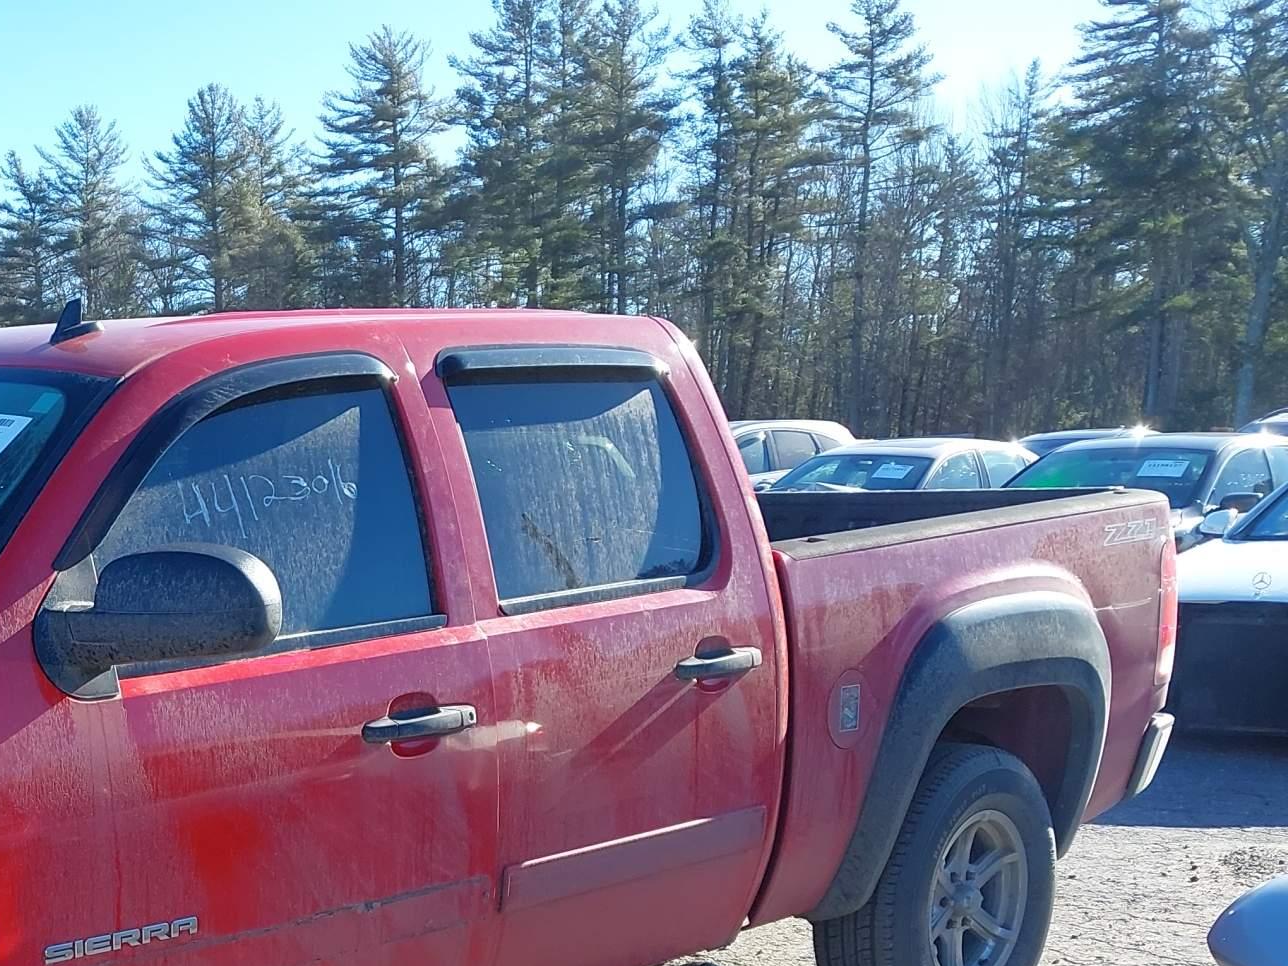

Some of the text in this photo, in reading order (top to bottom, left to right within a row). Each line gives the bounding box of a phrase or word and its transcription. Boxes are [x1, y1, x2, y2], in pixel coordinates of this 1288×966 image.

[176, 458, 358, 538] 44123016
[1104, 518, 1157, 546] Z71
[44, 915, 198, 965] SIERRA
